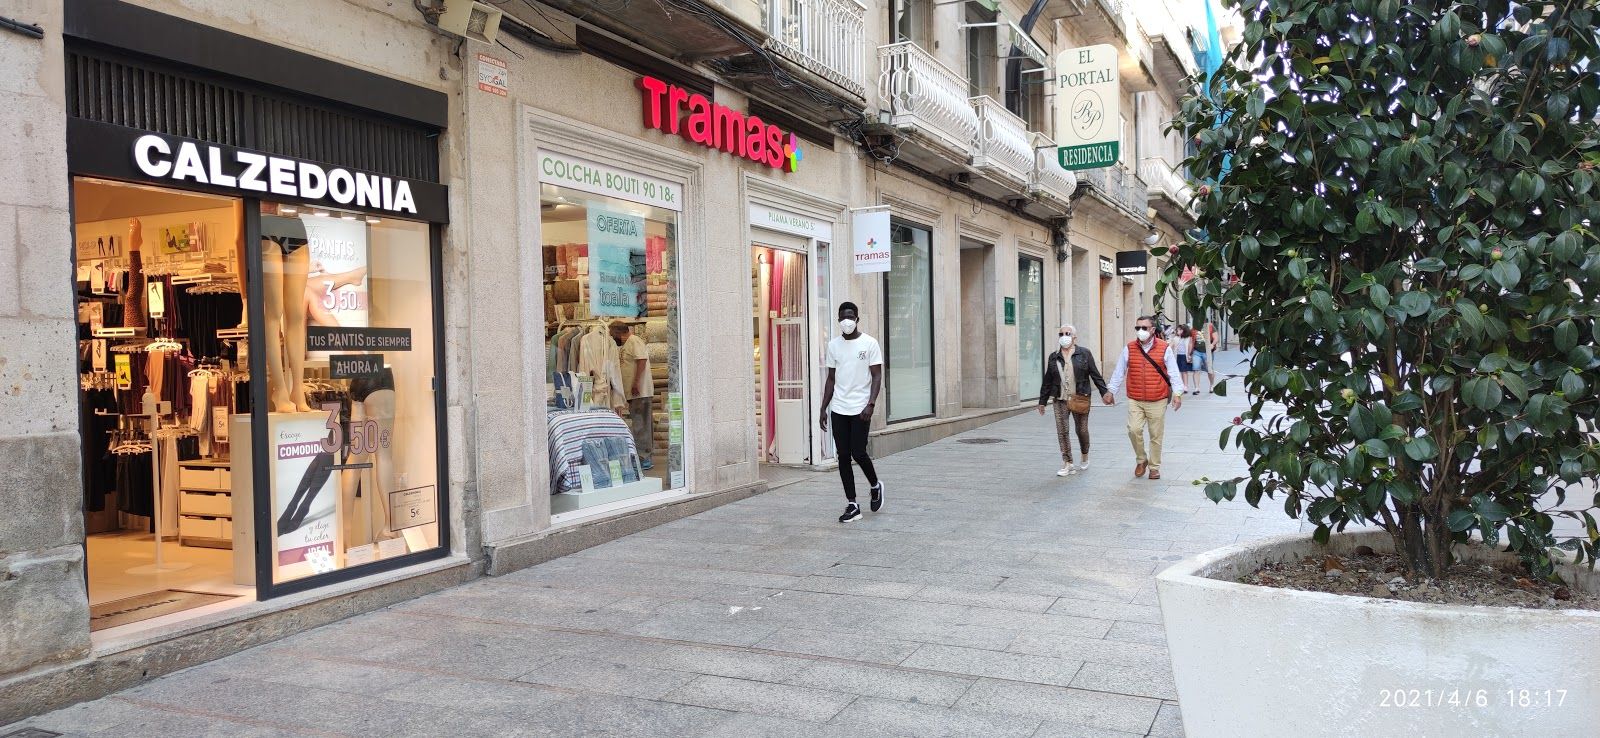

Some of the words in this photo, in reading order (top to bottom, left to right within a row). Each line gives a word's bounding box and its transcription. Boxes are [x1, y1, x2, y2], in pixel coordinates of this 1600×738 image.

[1079, 50, 1095, 65] EL
[1060, 69, 1114, 89] PORTAL
[643, 75, 785, 169] Tramas
[1063, 144, 1114, 166] RESIDENCIA
[134, 134, 418, 214] CALZEDONIA
[542, 157, 602, 186] COLCHA
[606, 172, 640, 195] BOUTI
[643, 181, 656, 199] 90
[597, 215, 638, 236] OFERTA
[311, 238, 354, 257] PANTIS
[309, 335, 326, 346] TUS
[327, 333, 365, 347] PANTIS
[366, 336, 376, 347] DE
[377, 336, 410, 347] SIEMPRE
[336, 360, 372, 374] AHORA
[373, 363, 379, 373] A
[280, 444, 326, 458] COMODIDA
